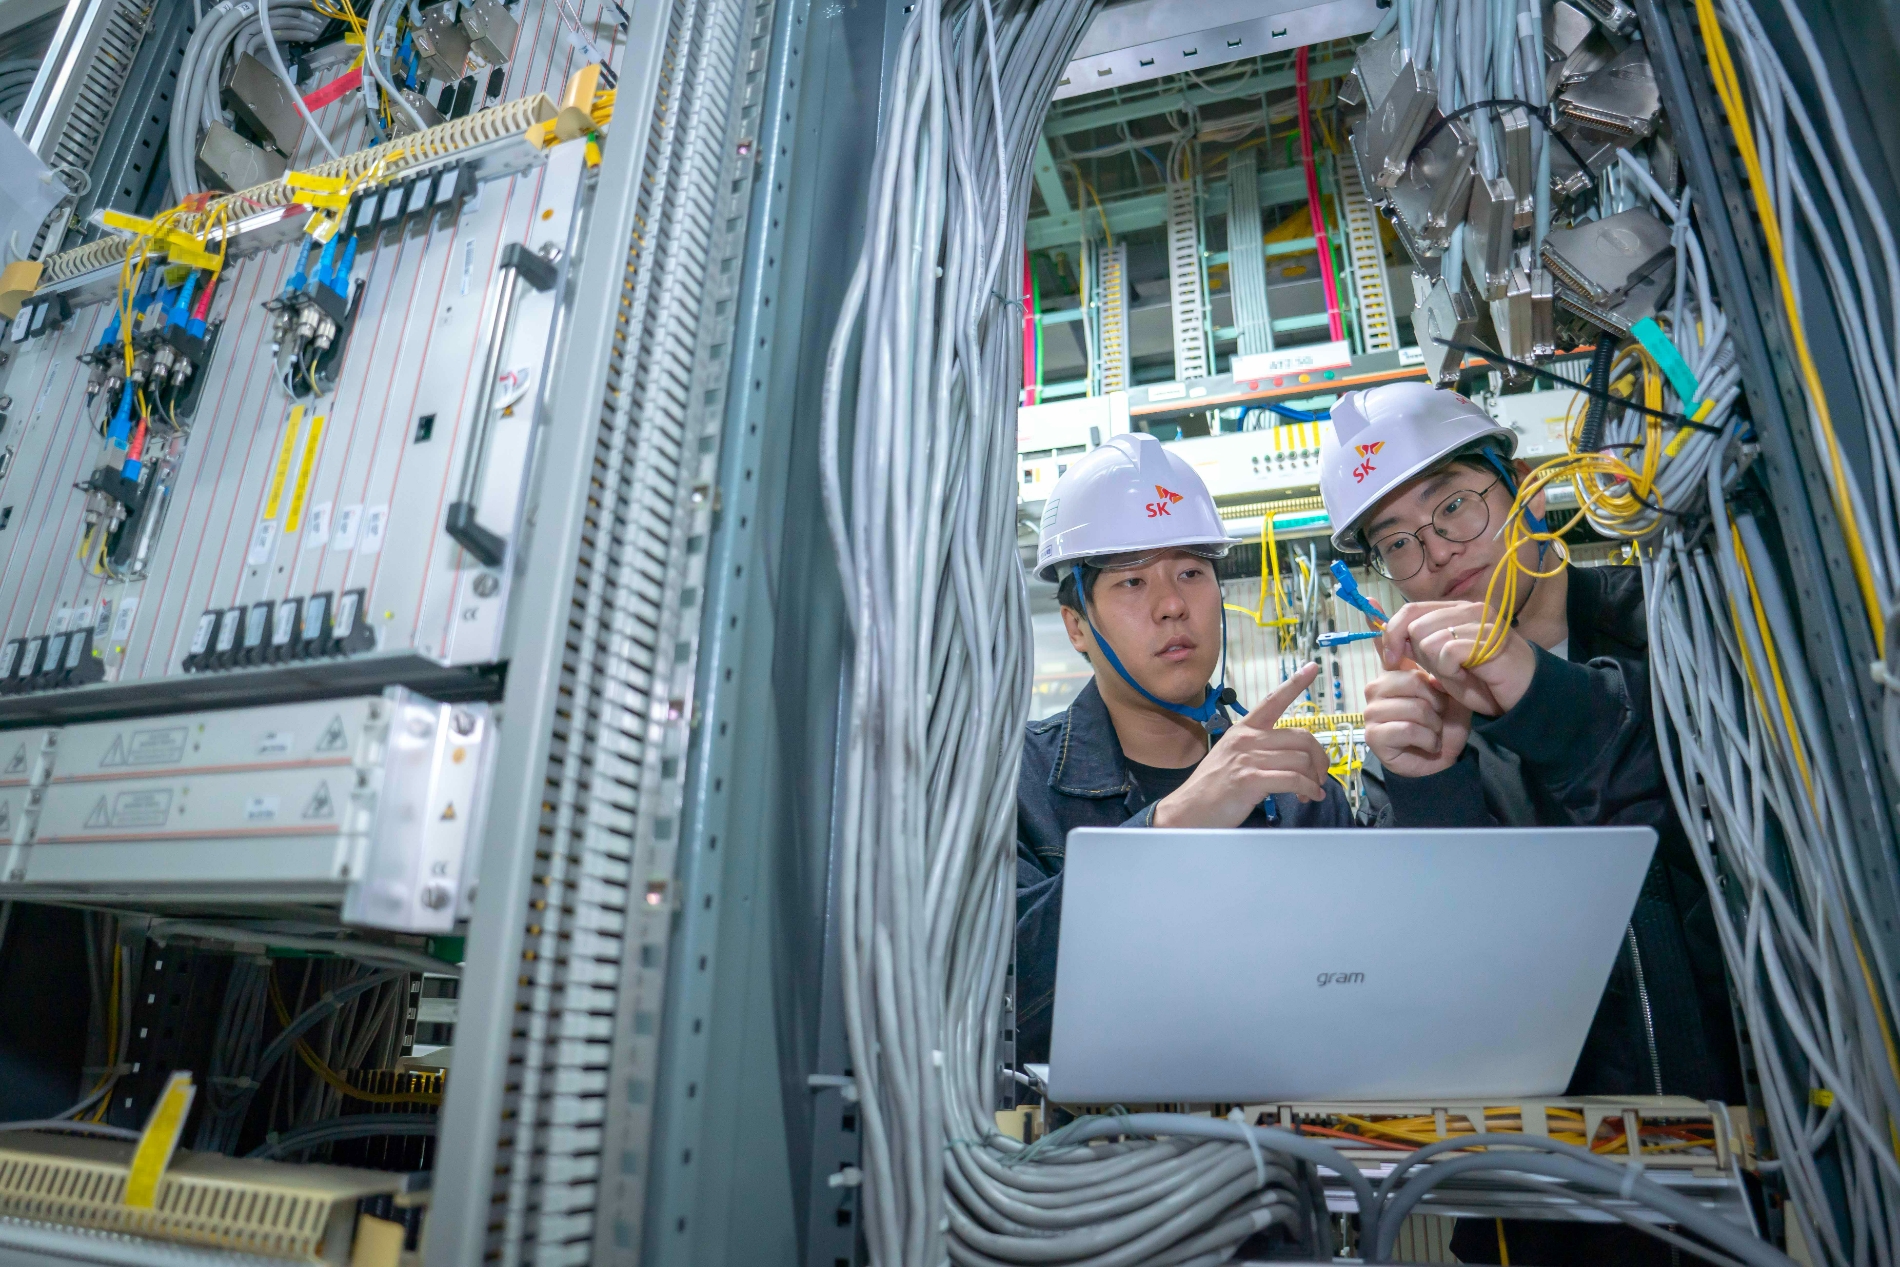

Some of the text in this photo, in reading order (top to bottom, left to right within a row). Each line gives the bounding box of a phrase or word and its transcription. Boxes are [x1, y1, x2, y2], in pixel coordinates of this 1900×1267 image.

[1353, 457, 1376, 484] SK
[1146, 502, 1171, 518] SK
[1316, 972, 1365, 987] gram
